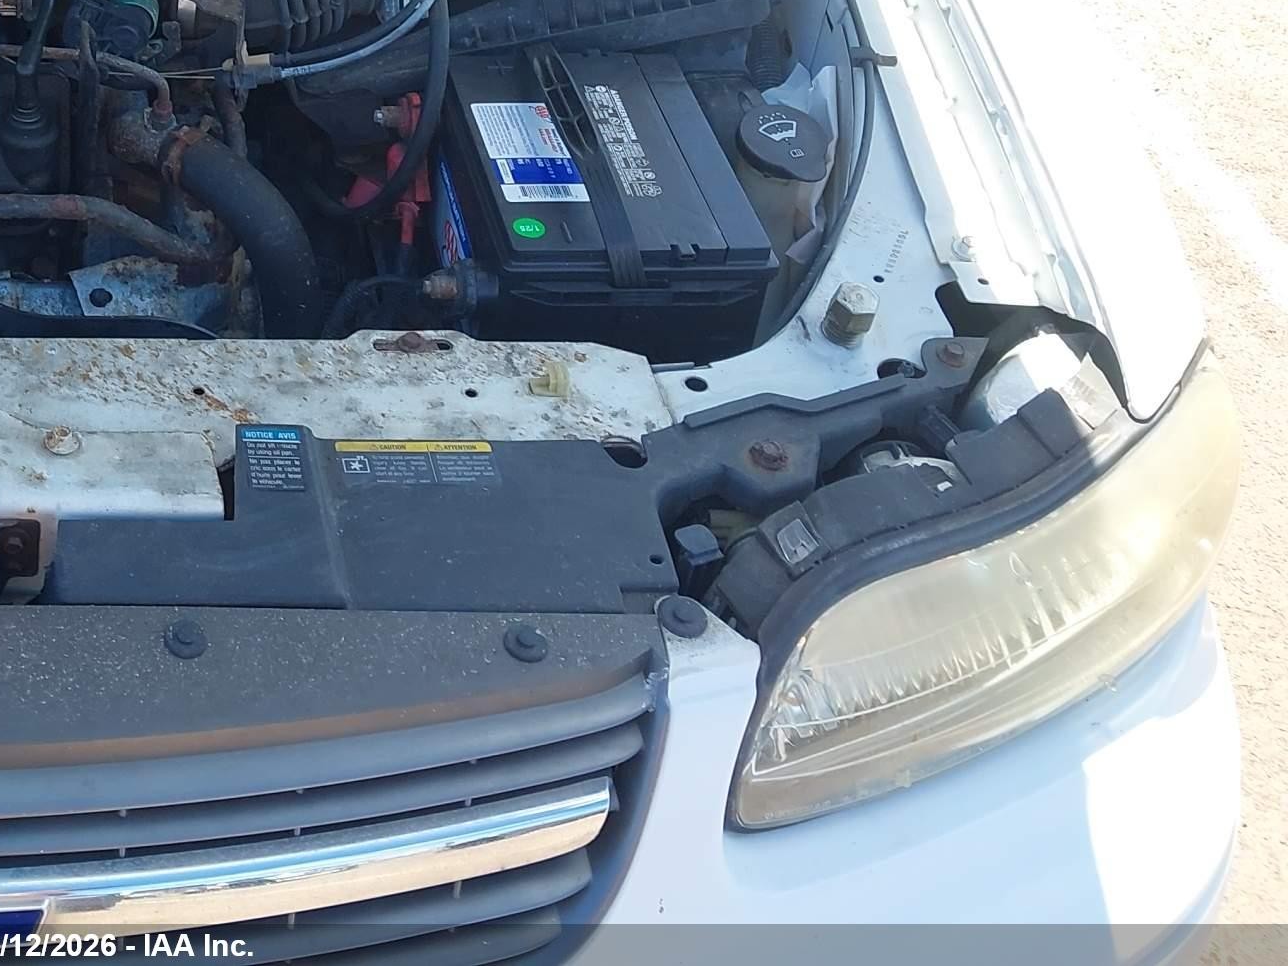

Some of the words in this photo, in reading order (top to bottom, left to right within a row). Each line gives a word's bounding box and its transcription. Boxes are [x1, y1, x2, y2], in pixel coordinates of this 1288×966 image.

[613, 94, 627, 118] DANGER
[621, 118, 639, 140] POISON
[519, 225, 540, 233] 1/25
[245, 431, 273, 439] NOTICE
